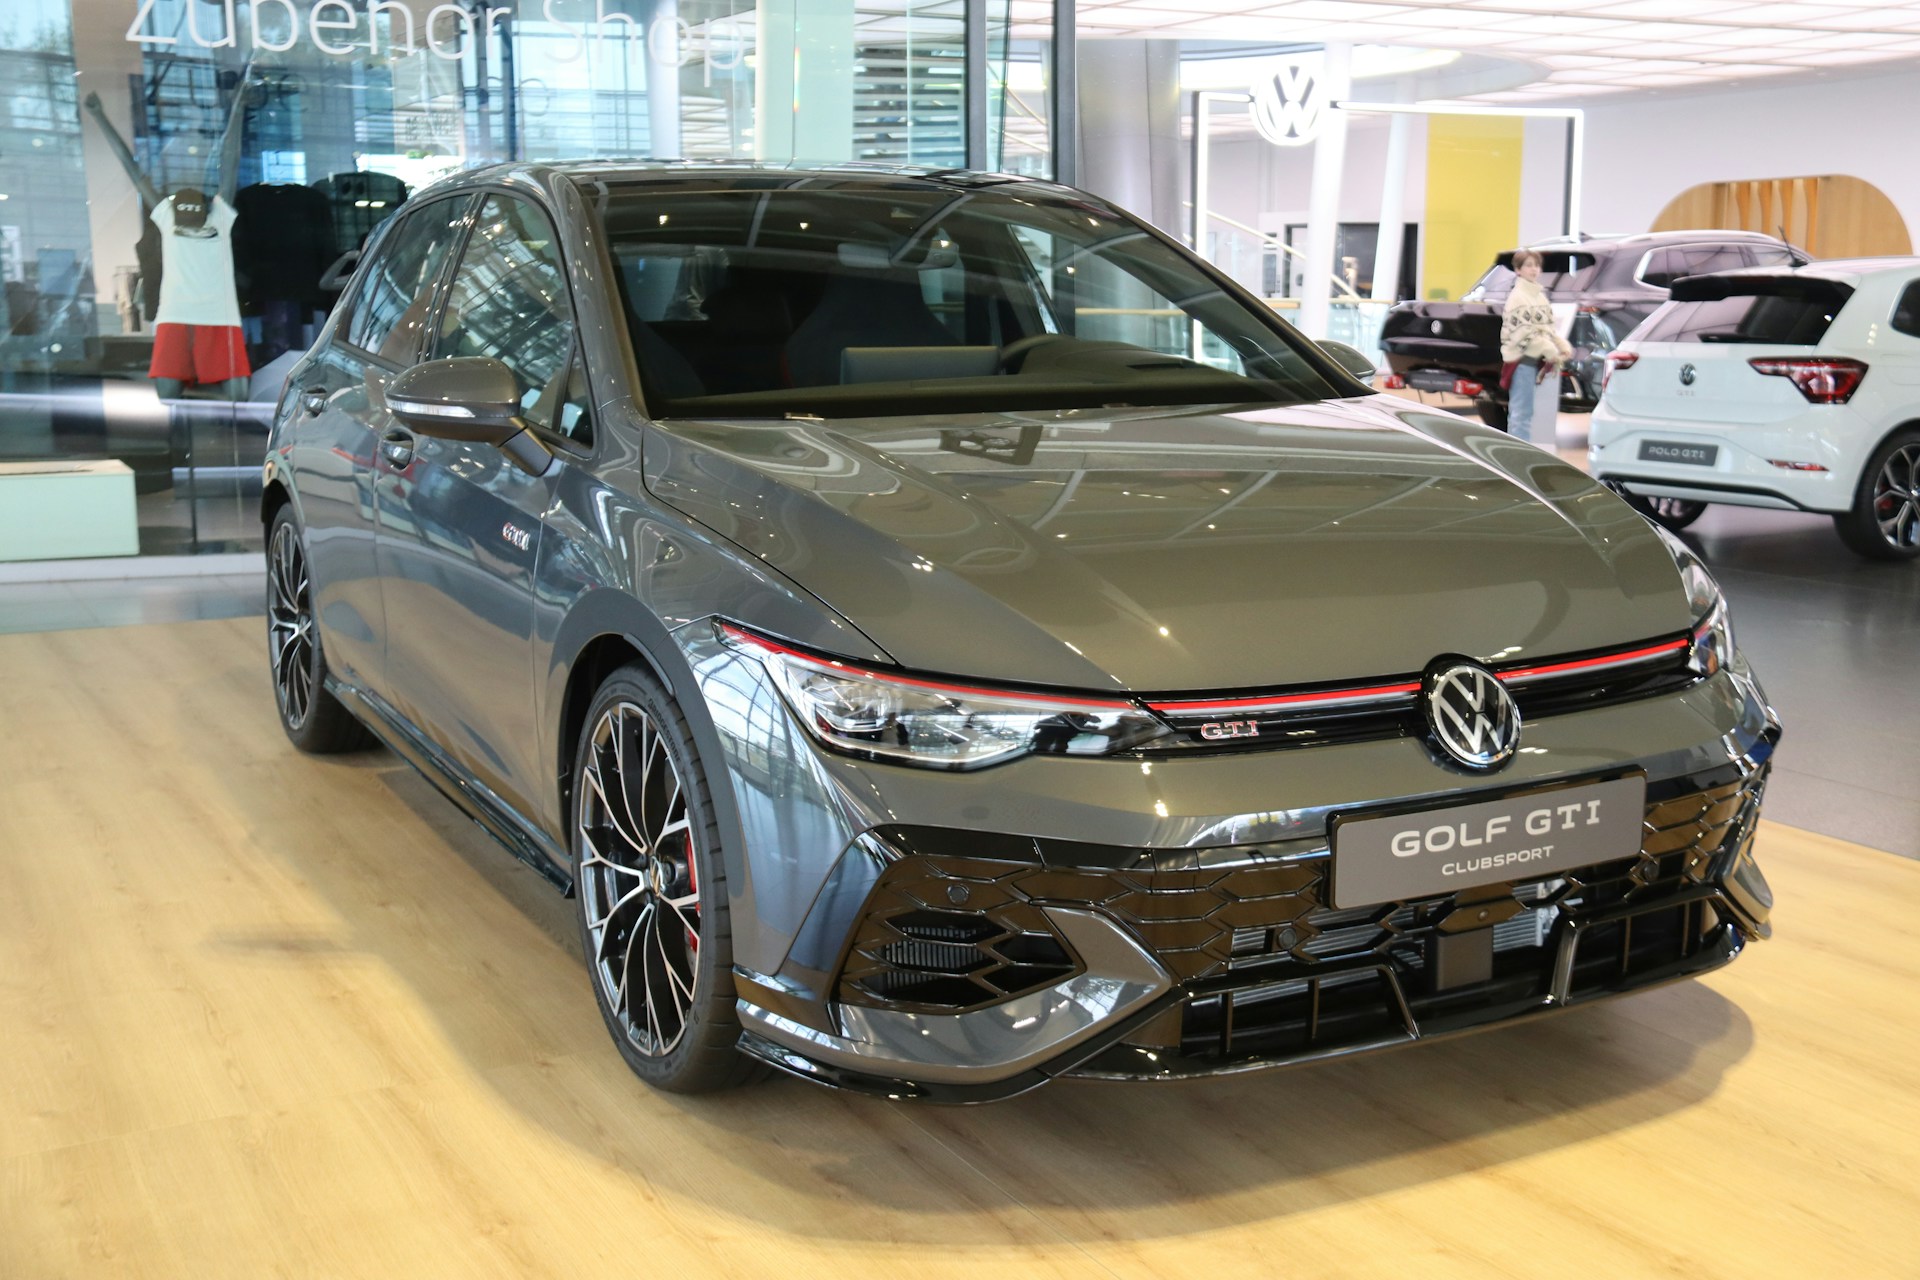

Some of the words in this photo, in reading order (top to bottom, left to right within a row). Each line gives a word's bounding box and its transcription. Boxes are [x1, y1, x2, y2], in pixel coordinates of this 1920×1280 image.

[542, 0, 745, 88] Shop
[1648, 446, 1679, 456] POLO
[1681, 448, 1705, 458] GTI
[1201, 720, 1259, 739] GTI
[1391, 816, 1512, 858] GOLF
[1525, 799, 1601, 836] GTI
[1441, 845, 1555, 876] CLUBSPORT
